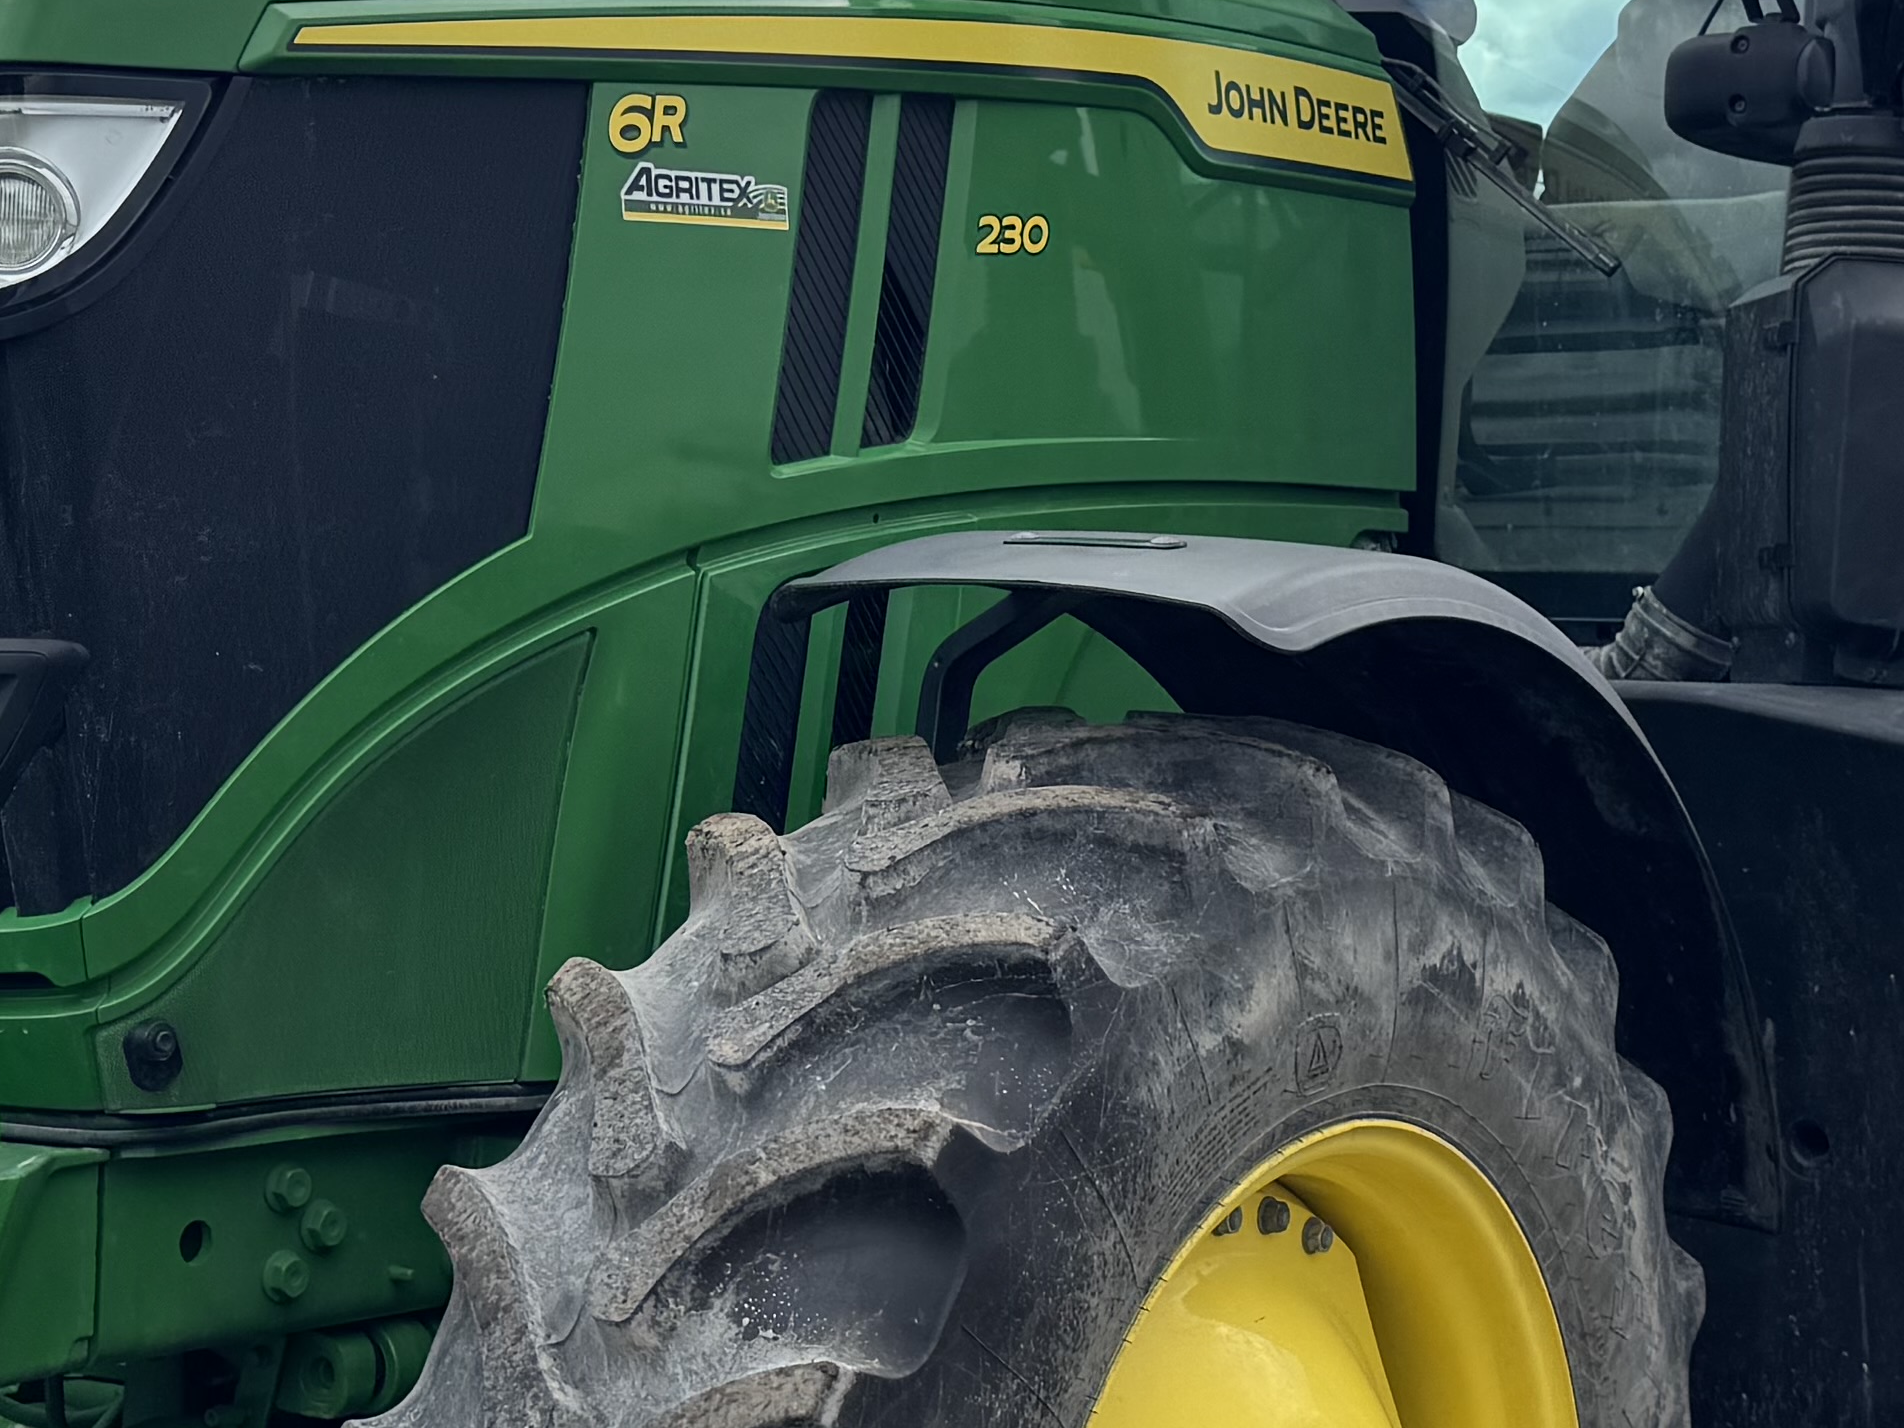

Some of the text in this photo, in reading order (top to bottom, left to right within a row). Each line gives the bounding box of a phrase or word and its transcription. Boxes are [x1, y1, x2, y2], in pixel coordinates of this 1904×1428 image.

[608, 93, 688, 154] 6R
[1208, 70, 1387, 145] JOHN DEERE
[624, 166, 754, 205] AGRITEX
[975, 215, 1050, 255] 230
